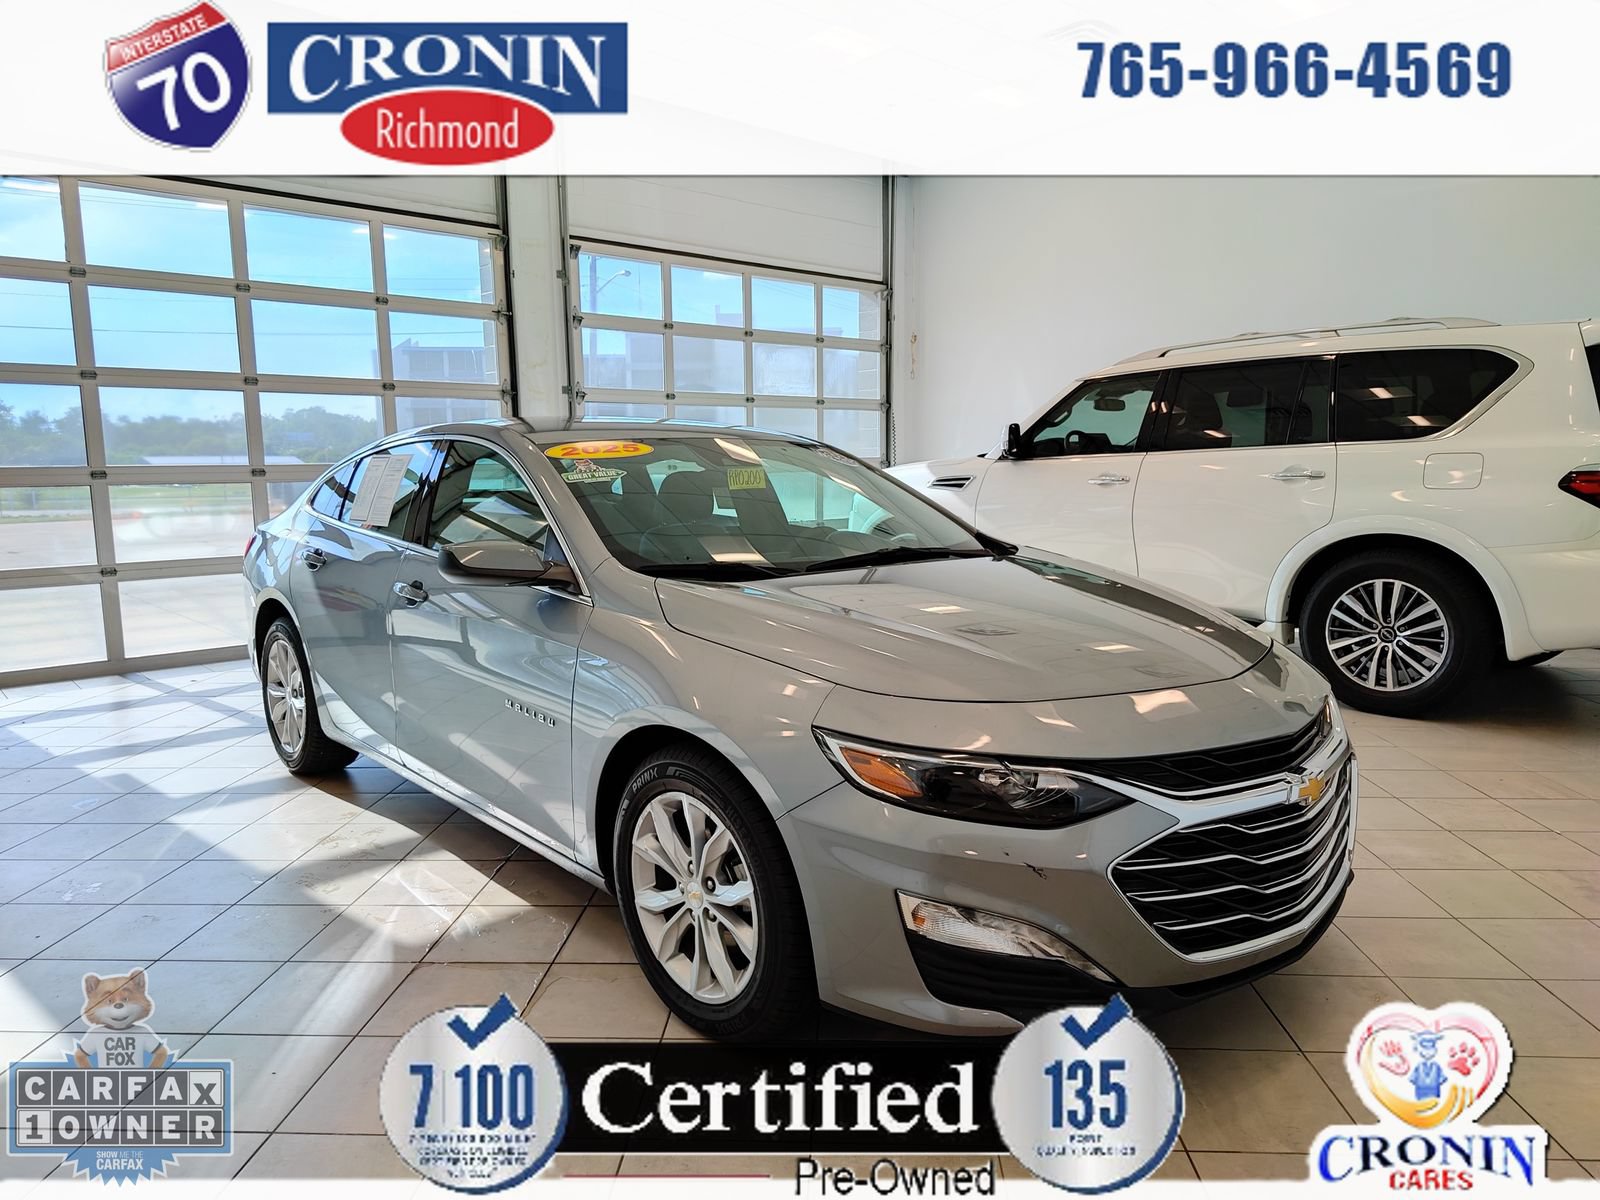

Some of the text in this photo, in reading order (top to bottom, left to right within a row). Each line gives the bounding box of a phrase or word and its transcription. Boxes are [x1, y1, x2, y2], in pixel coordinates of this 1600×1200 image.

[560, 443, 641, 457] 2025
[567, 472, 592, 480] GREAT
[593, 470, 618, 478] VALUE
[504, 699, 556, 728] MALIBU
[632, 768, 659, 793] PRINX
